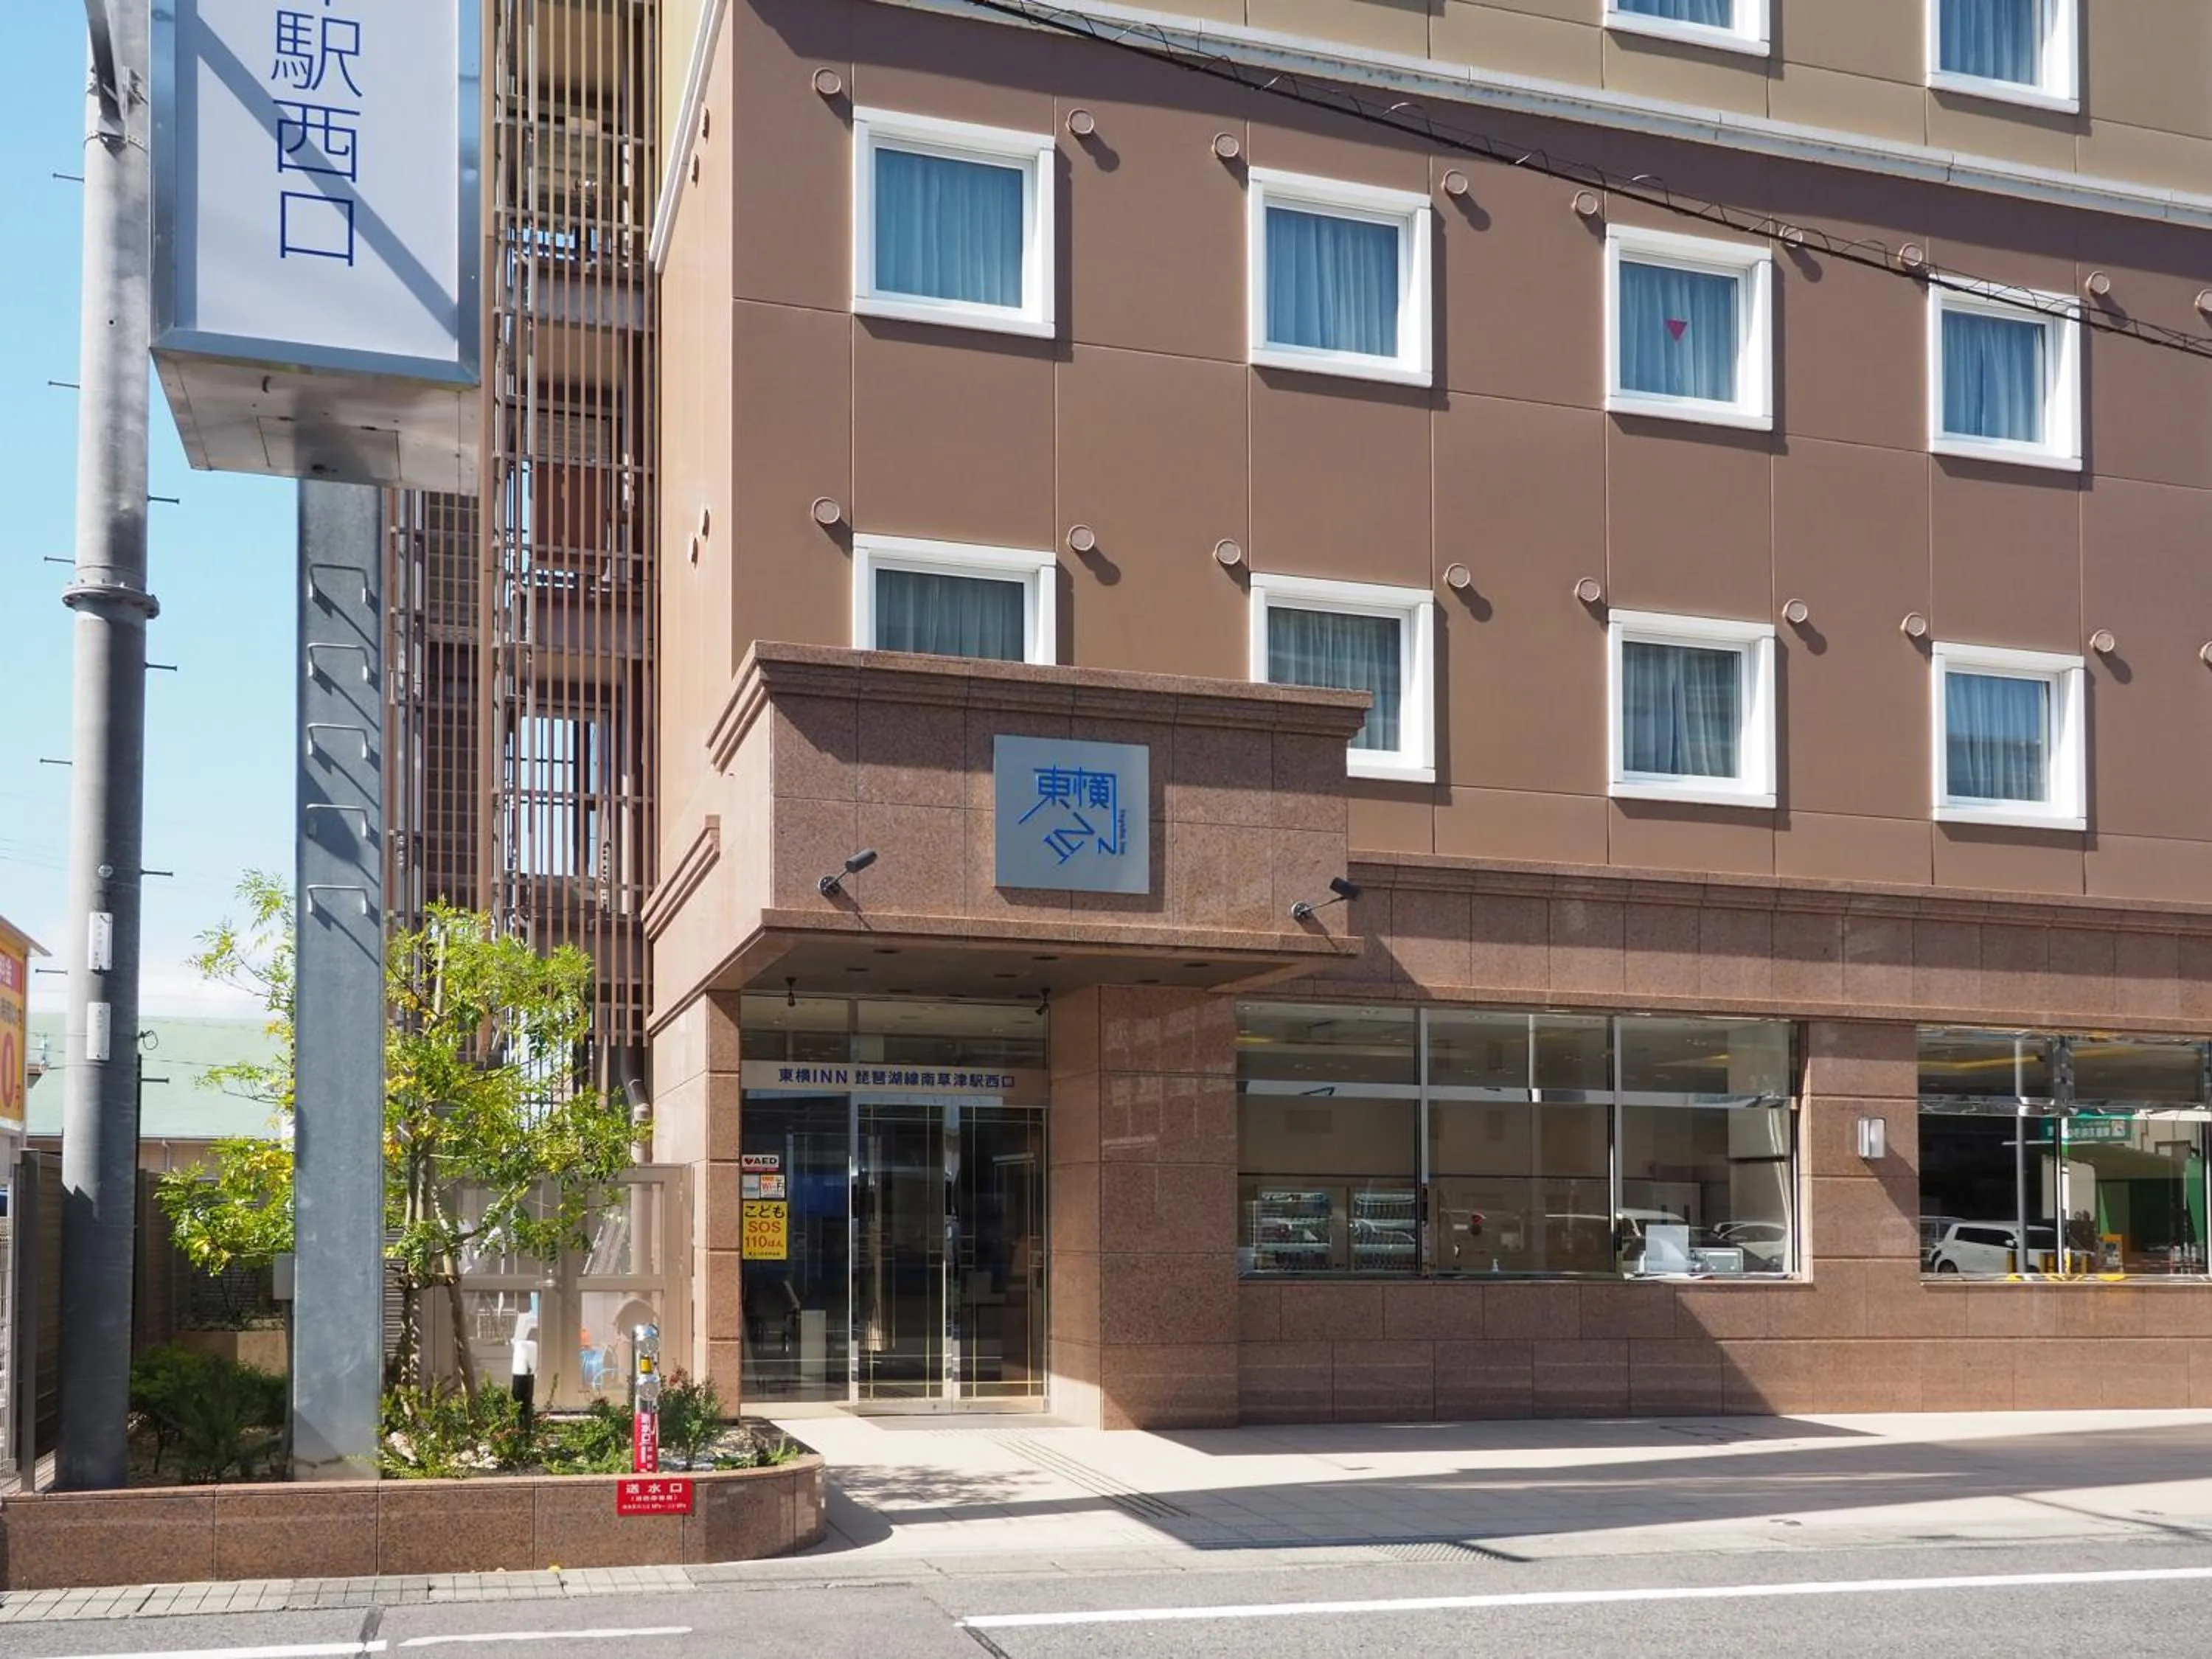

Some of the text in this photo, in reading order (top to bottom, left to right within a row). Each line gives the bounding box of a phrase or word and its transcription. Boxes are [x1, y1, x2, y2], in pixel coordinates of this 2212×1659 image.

[271, 0, 363, 267] 駅西口
[779, 1068, 1015, 1088] 東横INN 琵琶湖線南草津駅西口
[745, 1204, 785, 1219] こども
[748, 1220, 781, 1233] SOS
